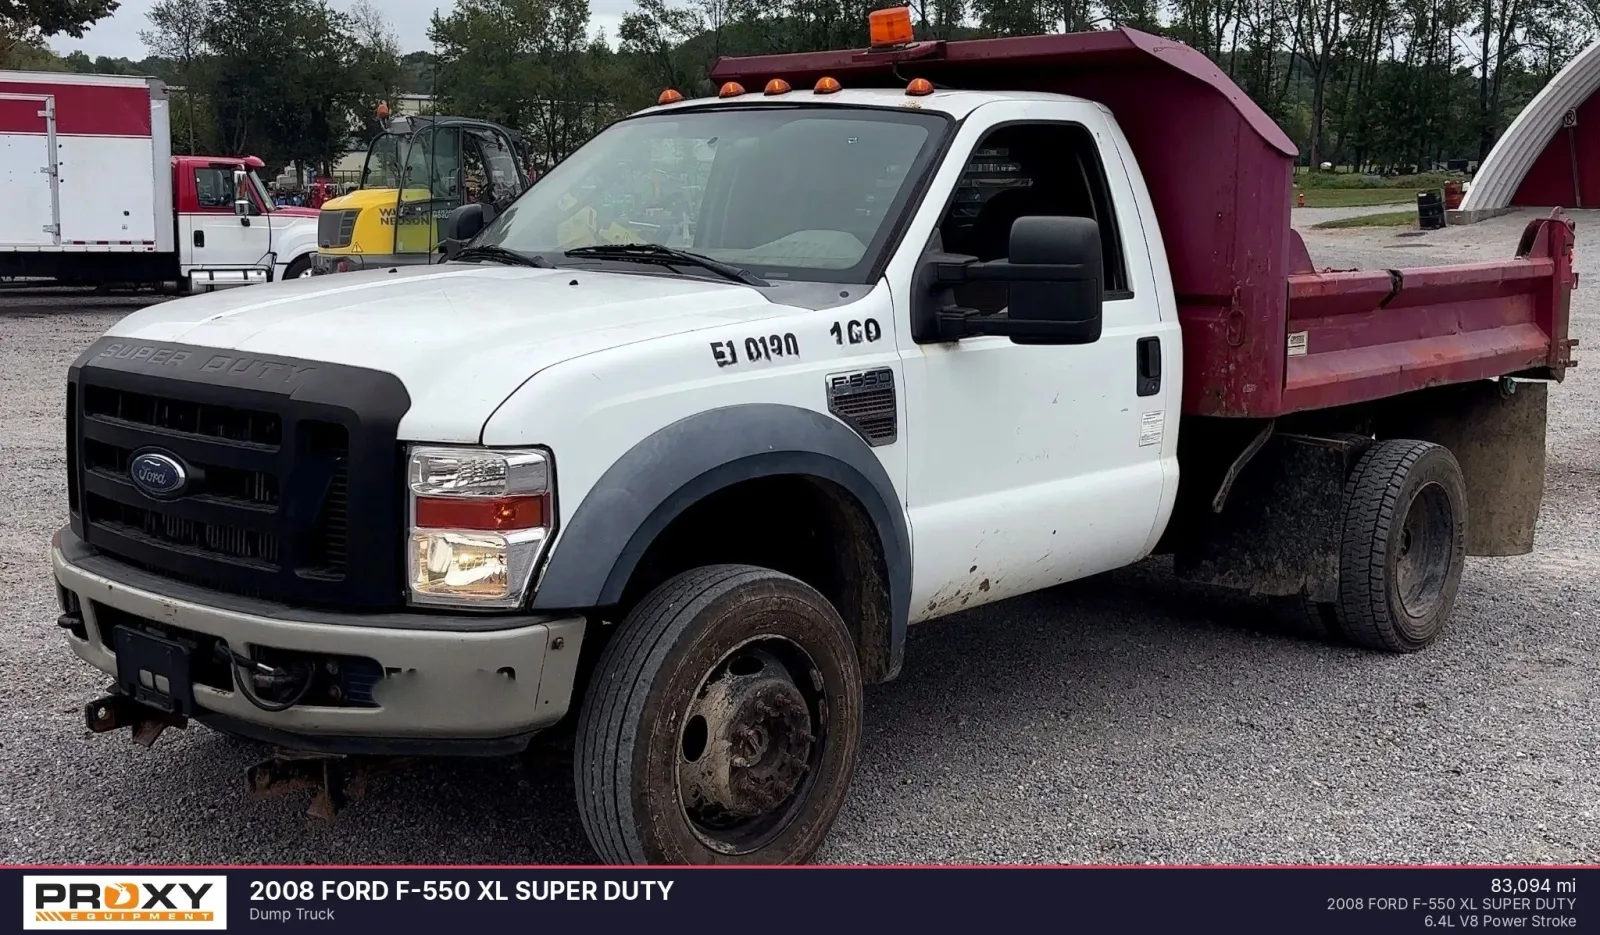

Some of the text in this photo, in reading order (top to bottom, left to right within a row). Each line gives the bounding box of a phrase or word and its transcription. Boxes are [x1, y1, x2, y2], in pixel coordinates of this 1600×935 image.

[100, 343, 318, 383] SUPER DUTY
[138, 464, 167, 485] Ford
